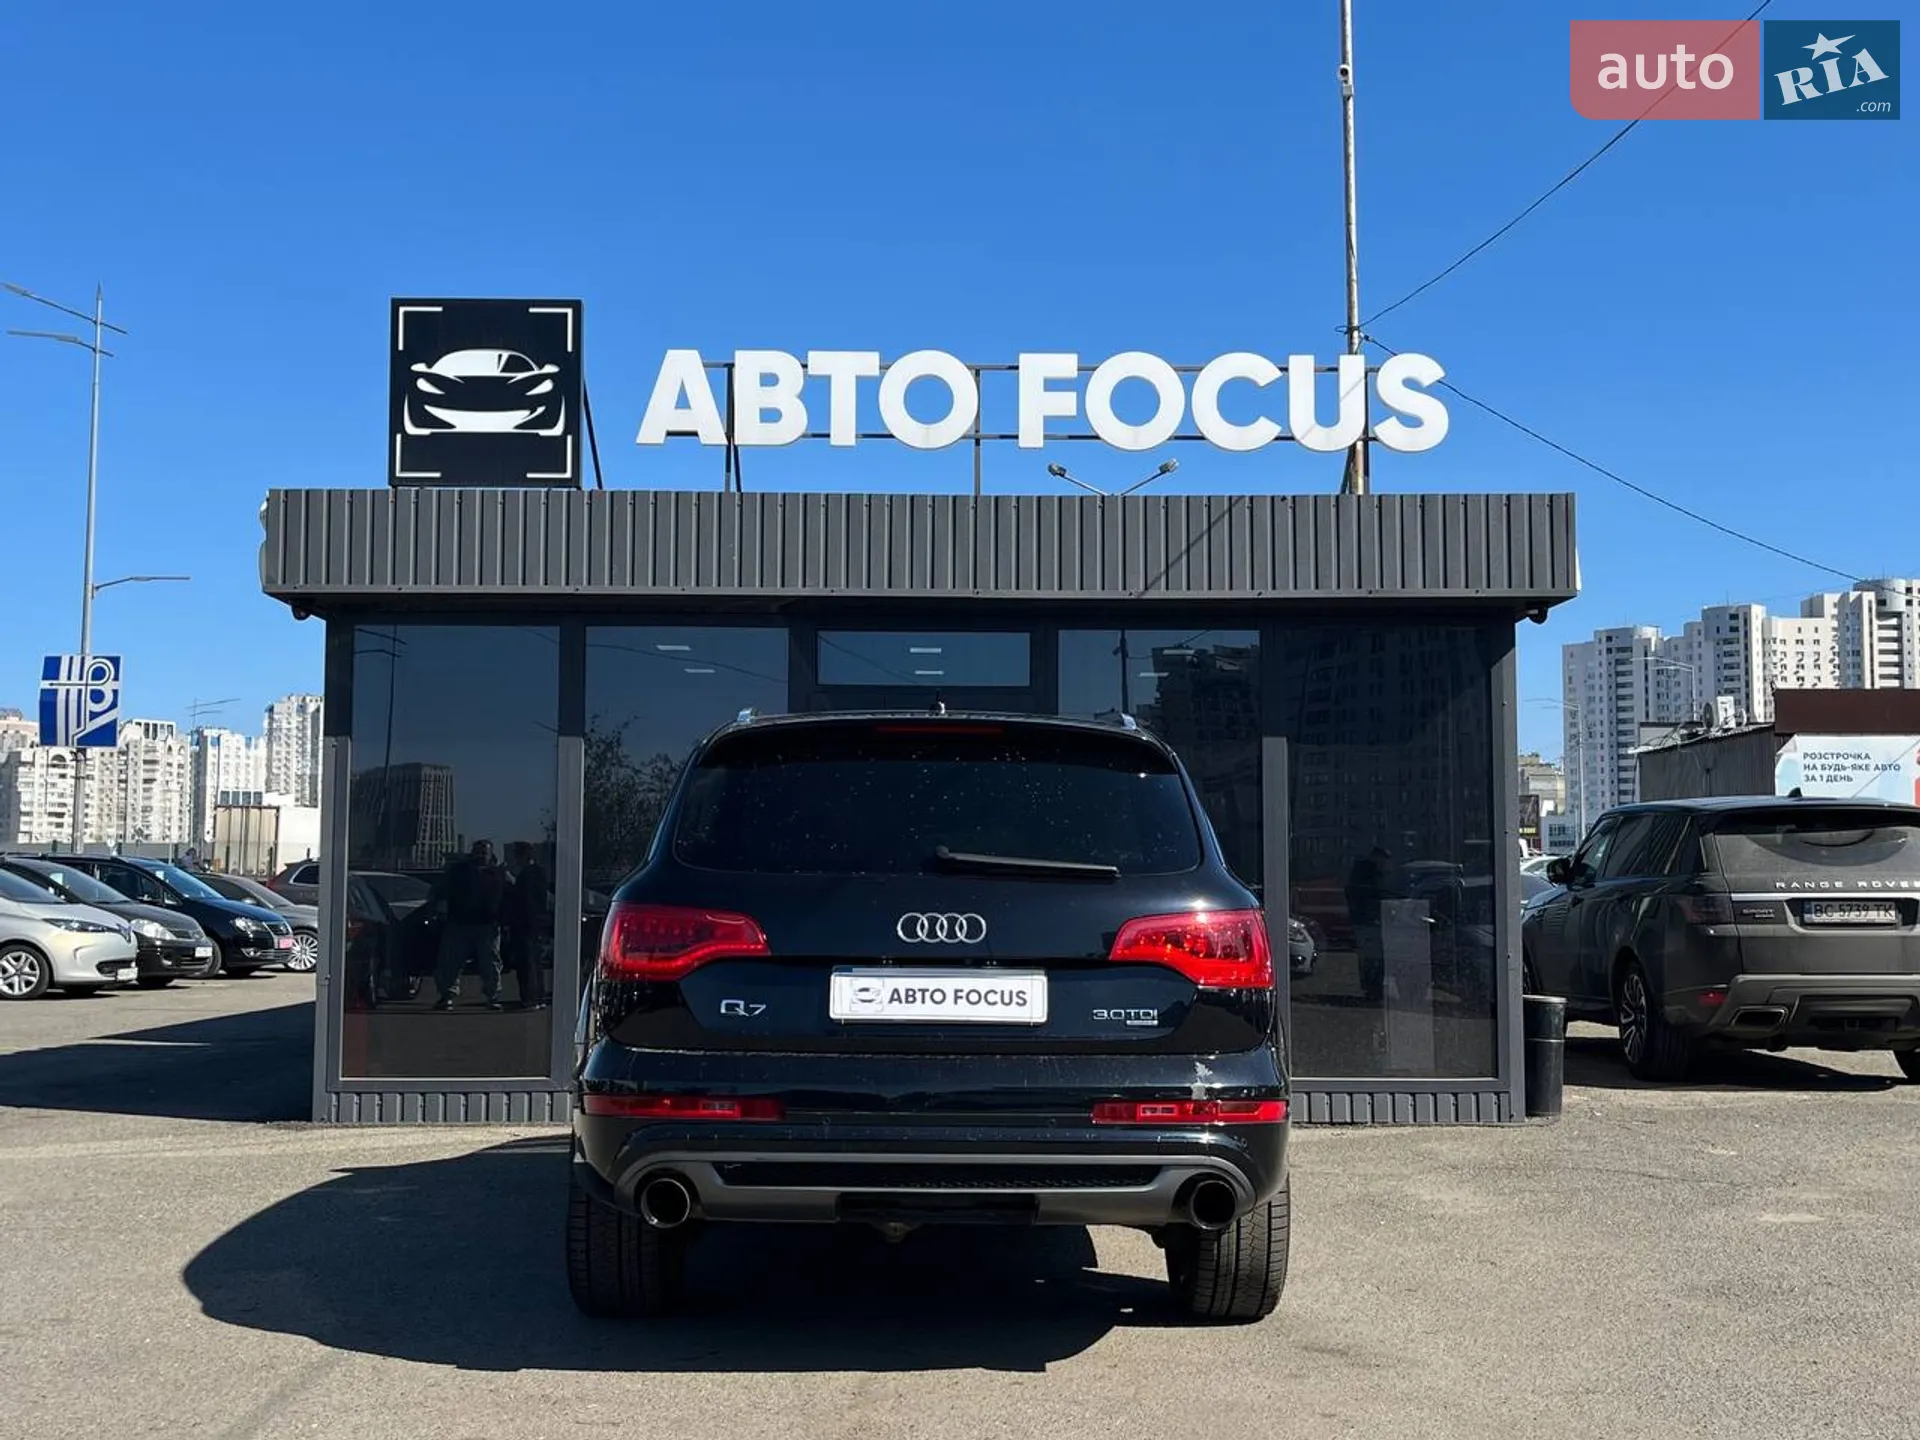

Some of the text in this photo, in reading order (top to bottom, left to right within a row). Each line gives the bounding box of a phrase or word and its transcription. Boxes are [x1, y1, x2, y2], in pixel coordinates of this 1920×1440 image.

[636, 348, 1450, 453] АВТО FOCUS
[1803, 752, 1871, 760] РОЗСТРОЧКА
[1820, 763, 1870, 772] БУДЬ-ЯКЕ
[1873, 763, 1901, 772] АВТО
[1804, 774, 1816, 782] ЗА
[1825, 775, 1853, 783] ДЕНЬ
[1814, 904, 1834, 918] BC
[1874, 904, 1893, 918] TK
[888, 988, 1027, 1007] АВТО FOCUS
[720, 999, 767, 1017] Q7
